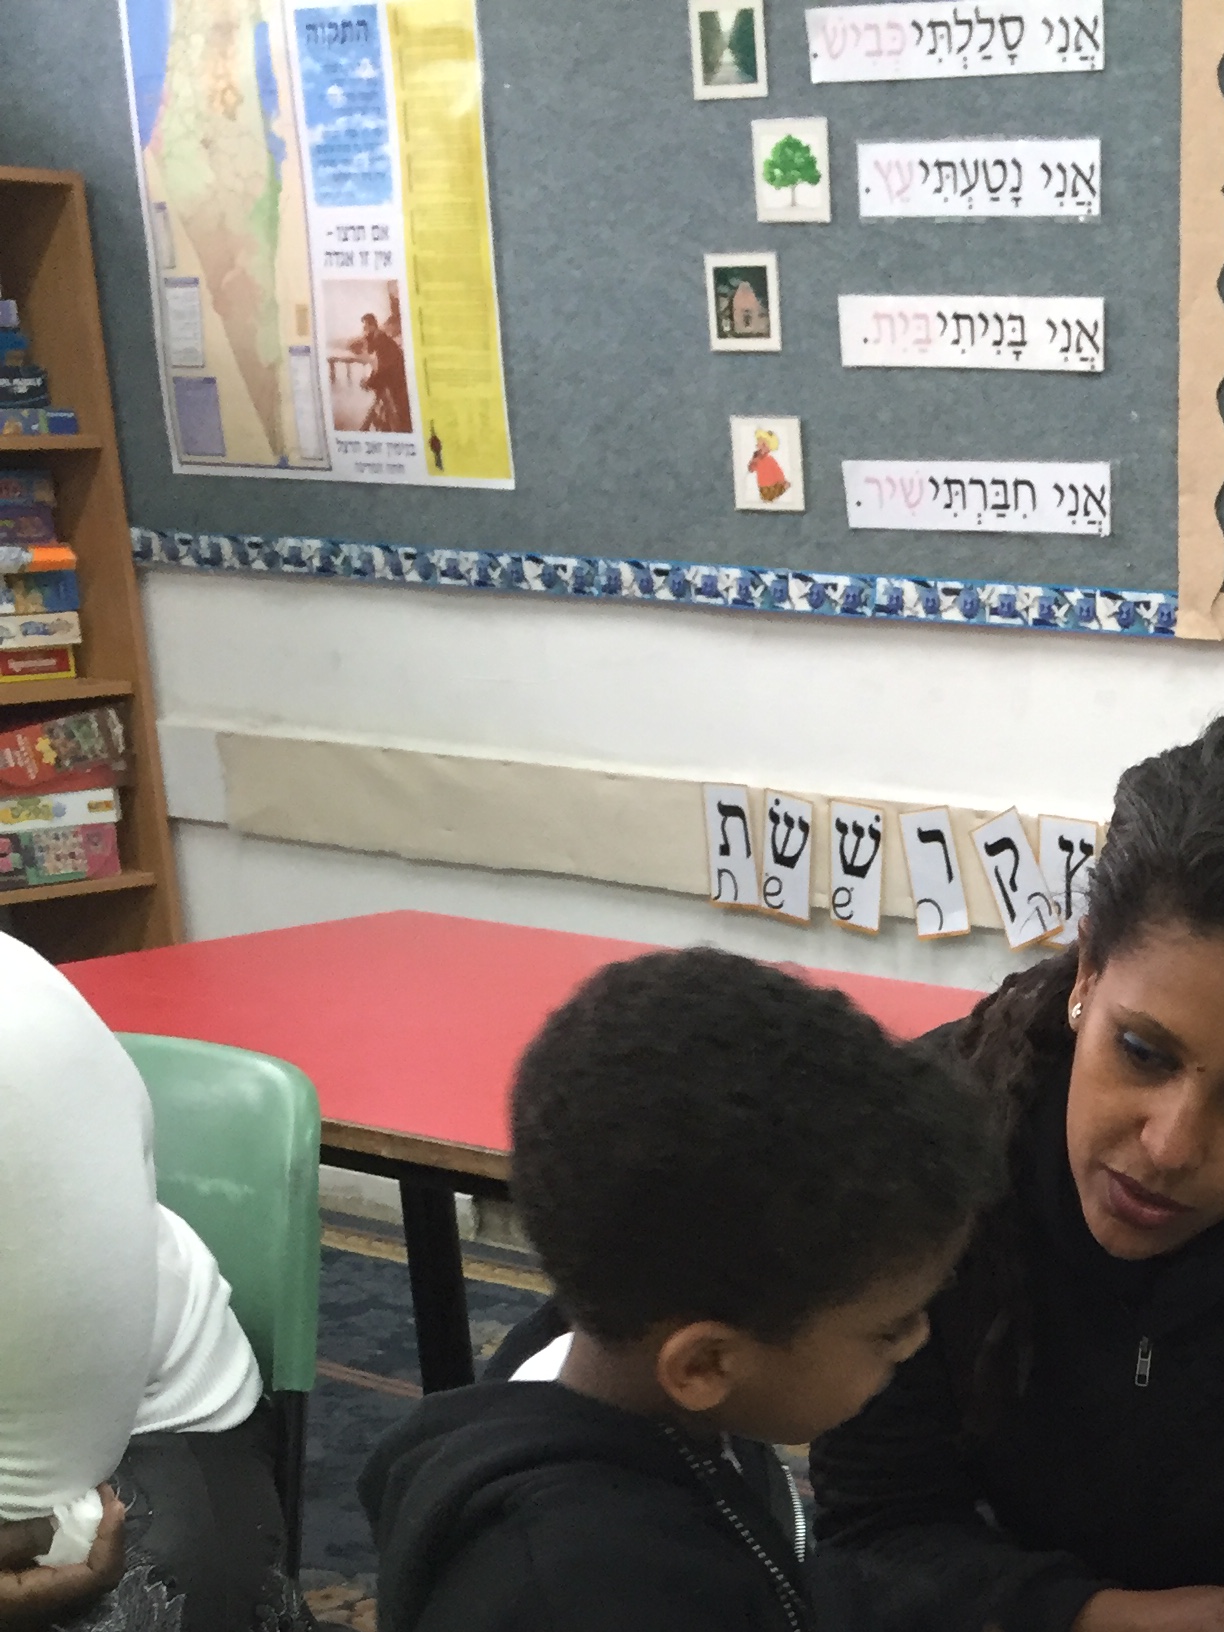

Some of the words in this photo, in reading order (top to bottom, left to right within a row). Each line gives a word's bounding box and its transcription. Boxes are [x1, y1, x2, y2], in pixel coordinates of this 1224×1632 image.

[717, 800, 752, 859] ת
[916, 826, 954, 884] ר
[984, 836, 1020, 924] ק
[1058, 834, 1094, 921] ץ
